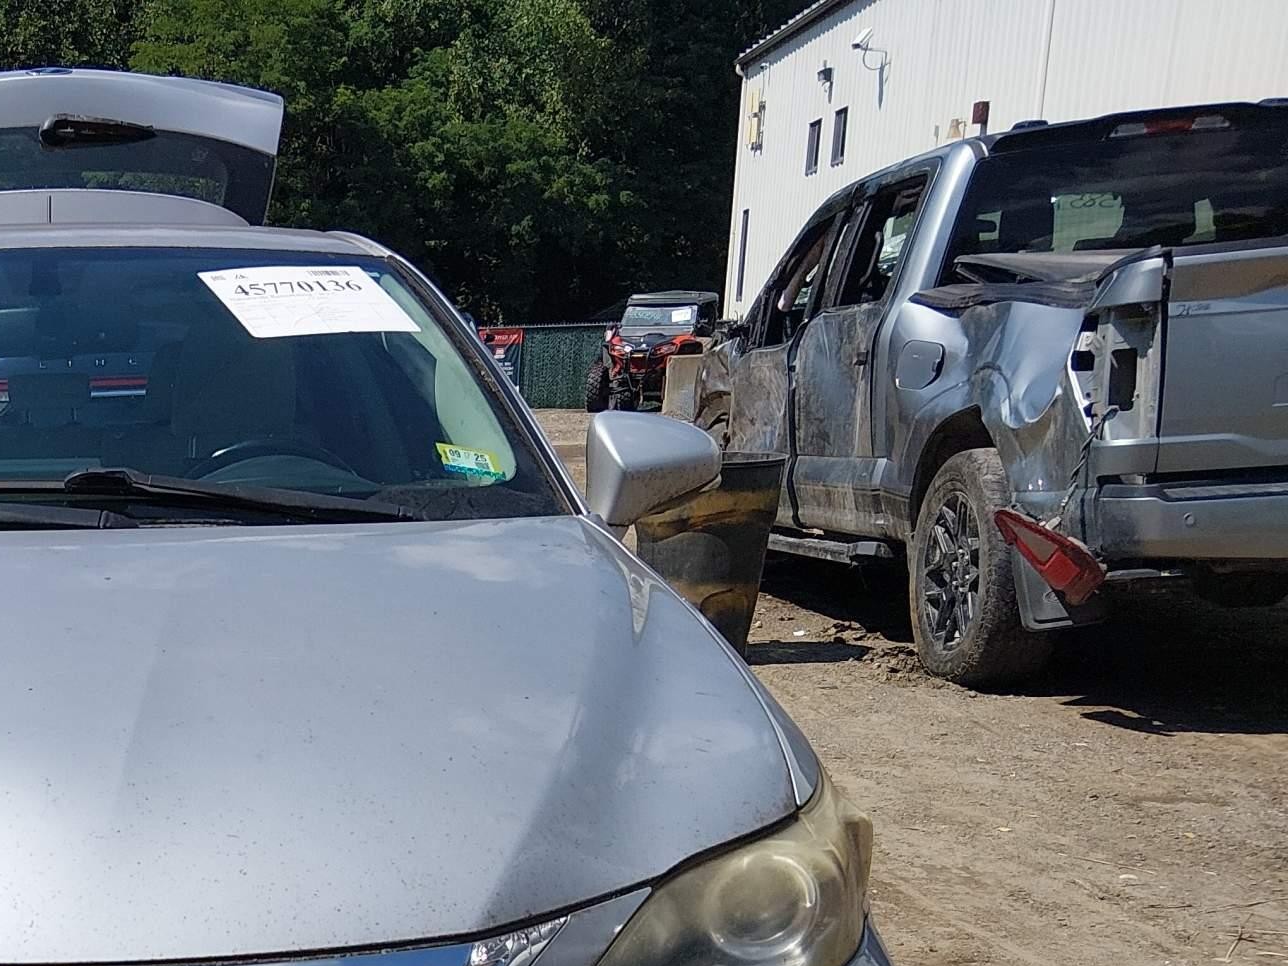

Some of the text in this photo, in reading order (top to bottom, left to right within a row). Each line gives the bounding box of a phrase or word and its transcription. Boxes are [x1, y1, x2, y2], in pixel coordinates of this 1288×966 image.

[234, 279, 363, 296] 45770136
[448, 448, 487, 462] 09 25
